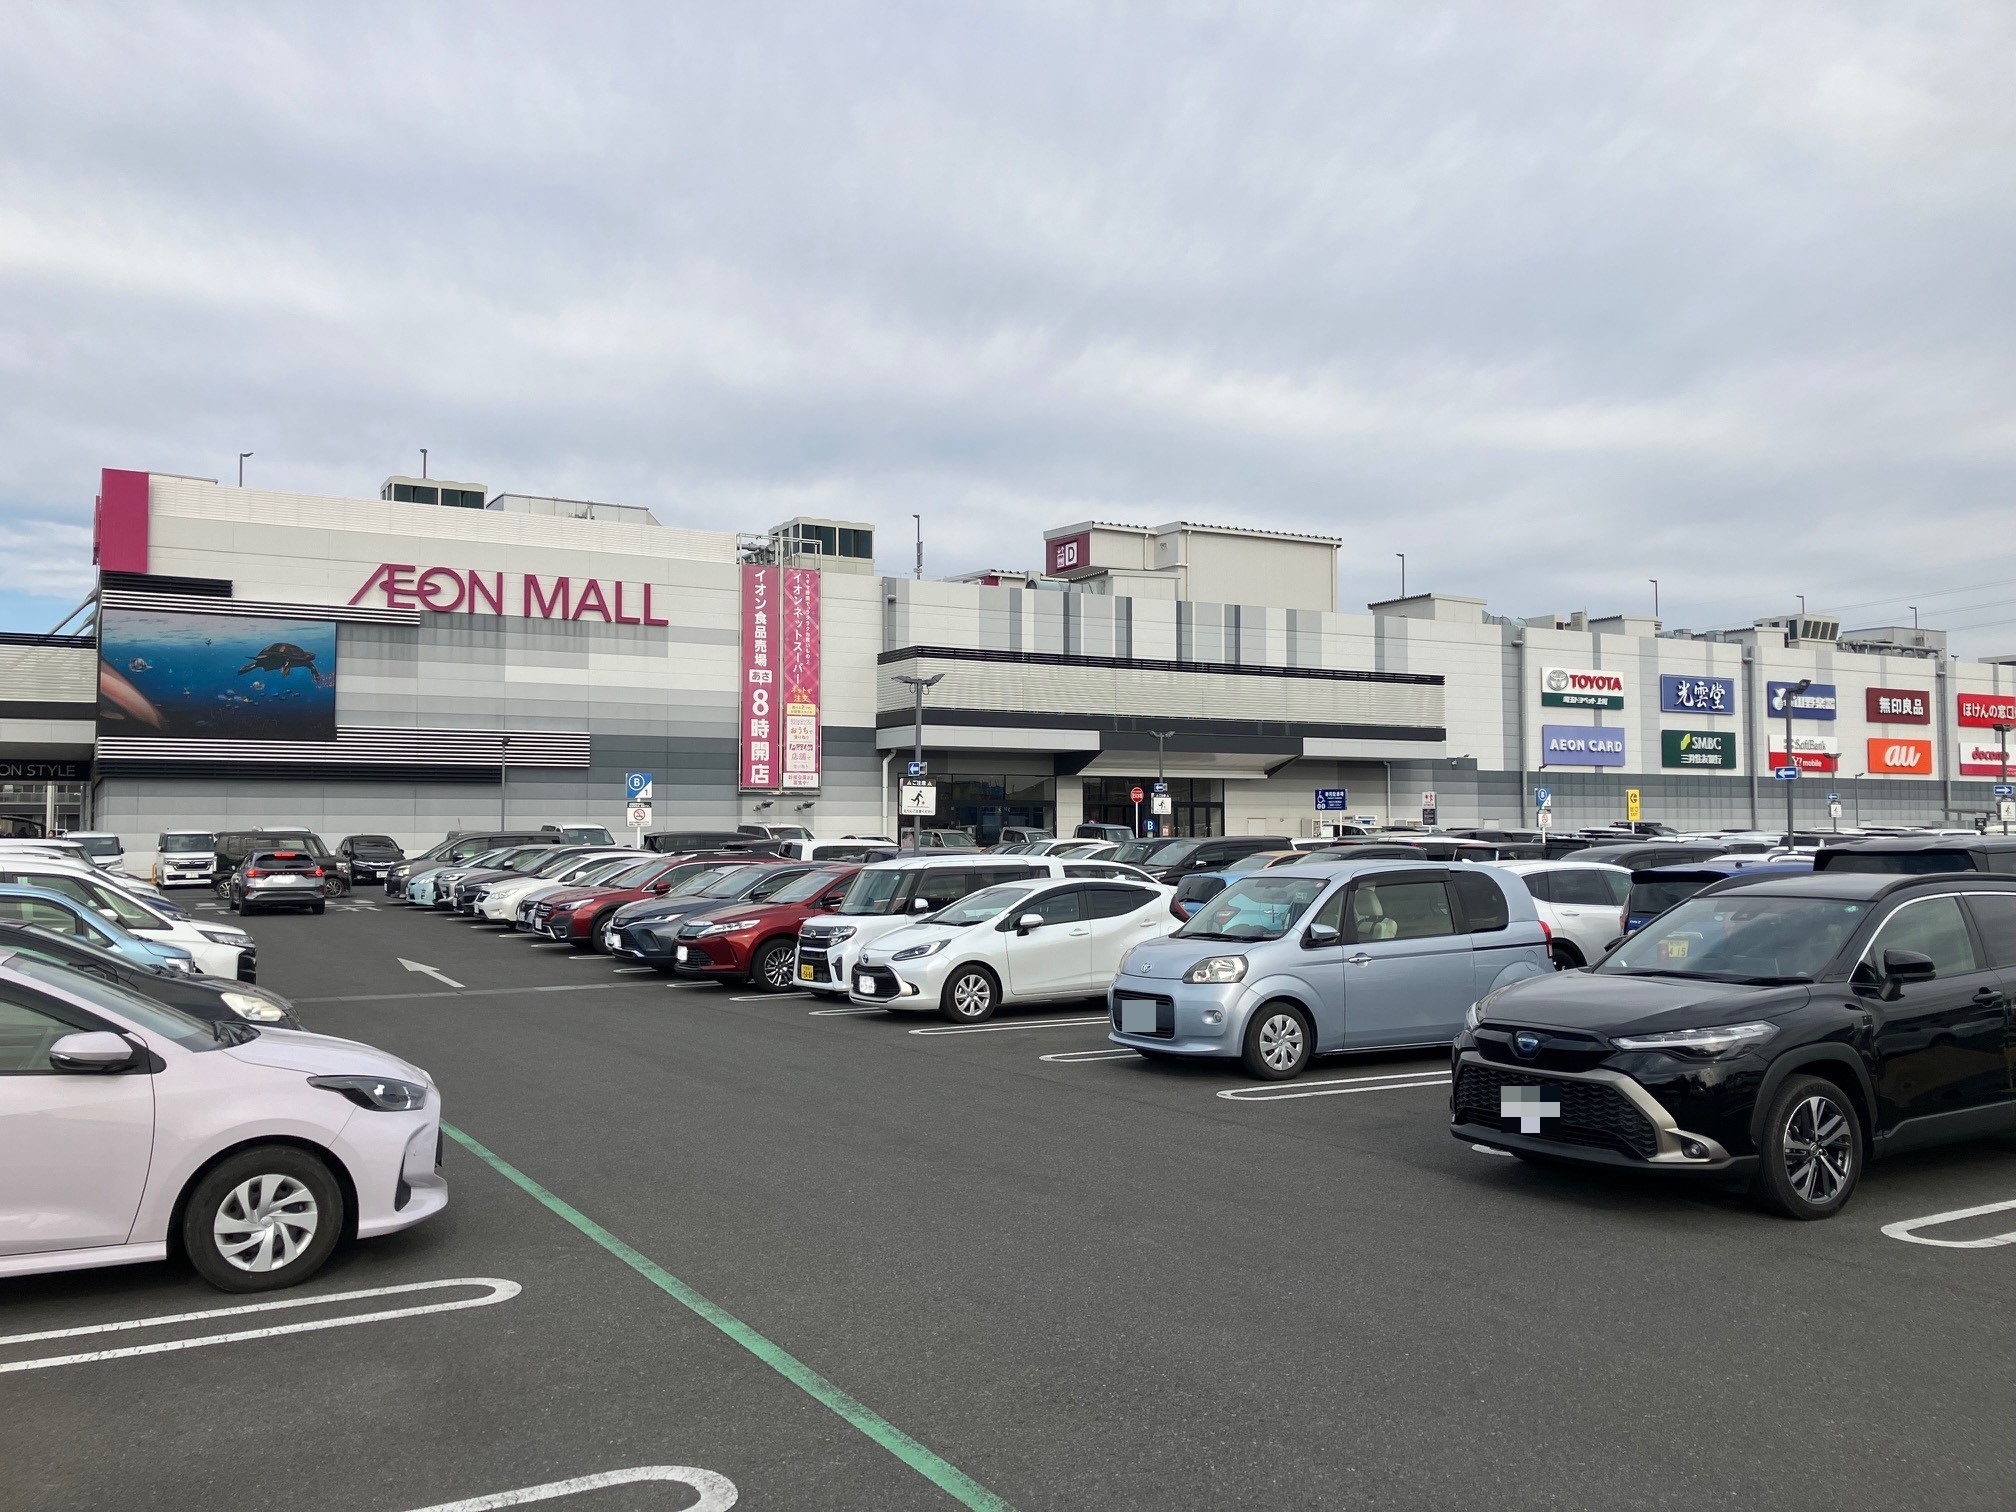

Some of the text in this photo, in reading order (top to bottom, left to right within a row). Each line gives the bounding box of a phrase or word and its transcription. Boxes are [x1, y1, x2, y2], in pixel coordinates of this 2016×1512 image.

[1068, 546, 1075, 562] D
[524, 574, 669, 627] MALL
[754, 569, 767, 667] イオン食品売場
[793, 573, 803, 684] イオンネットスーパー
[1569, 674, 1623, 691] TOYOTA
[1675, 680, 1726, 710] 光雲堂
[1879, 696, 1924, 716] 無印良品
[1962, 703, 2015, 719] ほけんの窓口
[1550, 738, 1623, 753] AEON CARD
[1691, 736, 1722, 750] SMBC
[1794, 739, 1826, 750] SoftBank
[1884, 745, 1921, 767] au
[27, 764, 76, 777] STYLE
